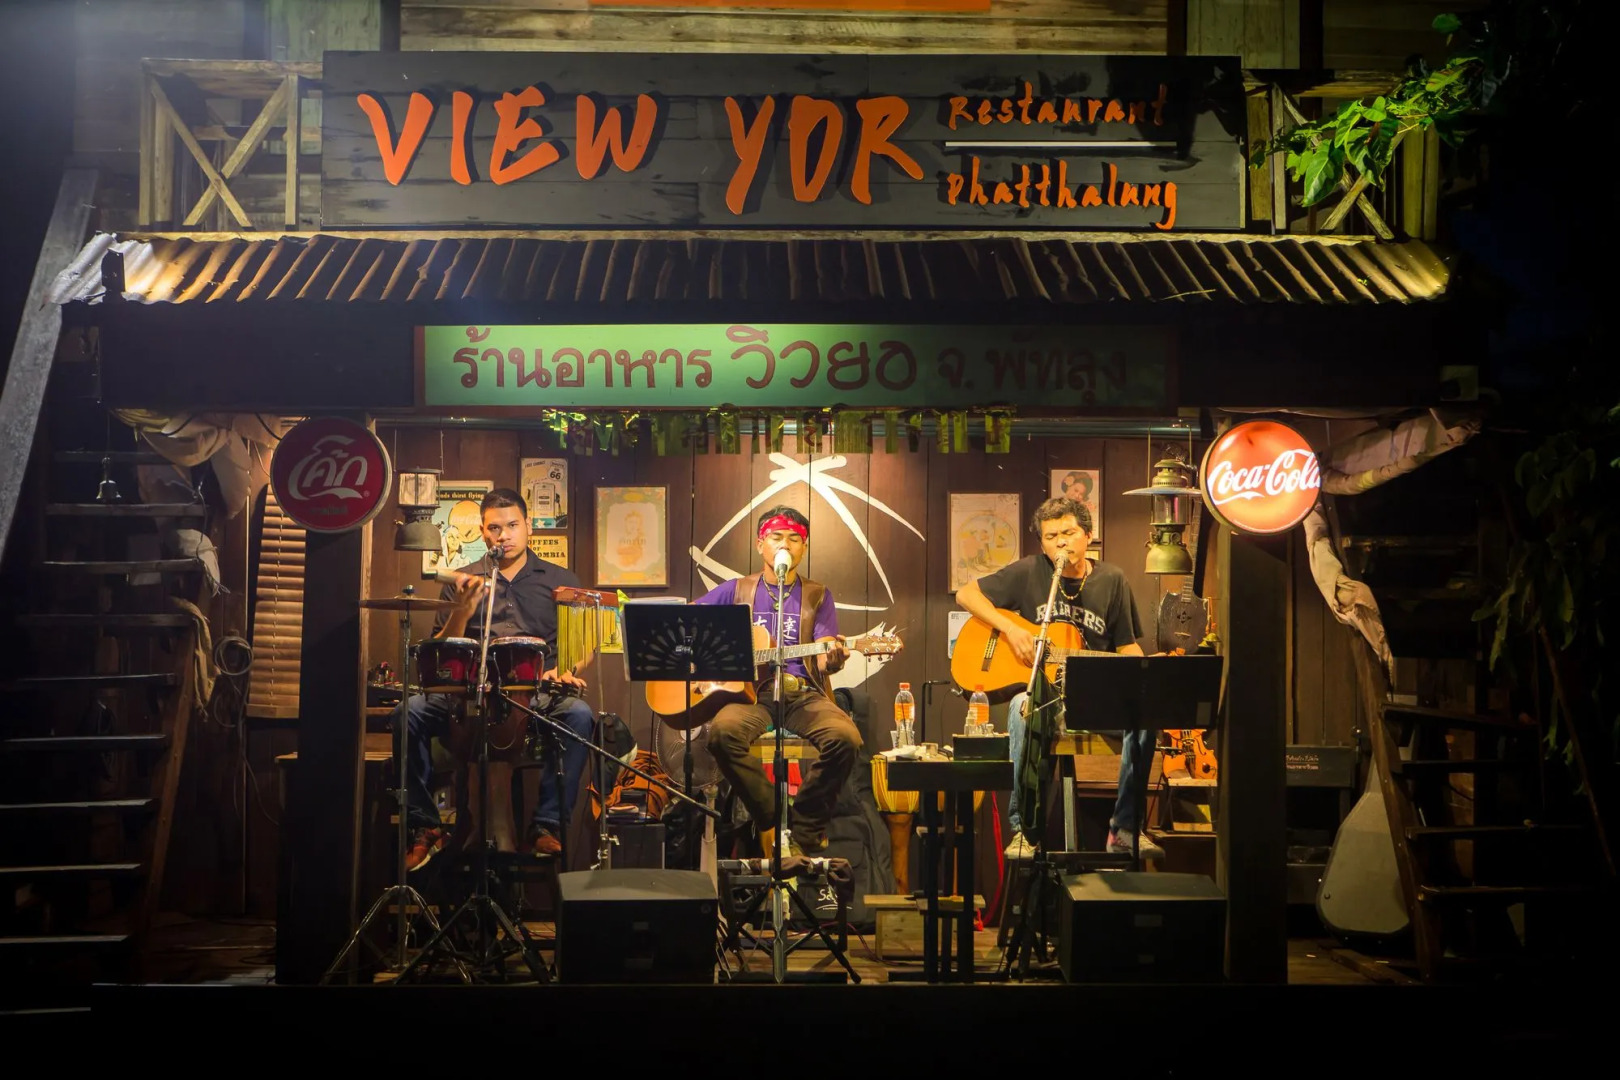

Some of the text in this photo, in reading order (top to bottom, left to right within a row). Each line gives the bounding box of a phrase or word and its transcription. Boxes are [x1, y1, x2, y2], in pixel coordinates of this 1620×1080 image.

[948, 80, 1168, 131] Restaurant
[357, 85, 924, 215] VIEW YOR
[453, 325, 713, 389] ร้านอาหาร
[725, 324, 918, 391] วิวยอ
[468, 491, 485, 501] flying
[549, 470, 561, 480] 66
[1207, 448, 1321, 506] Coca-Cola
